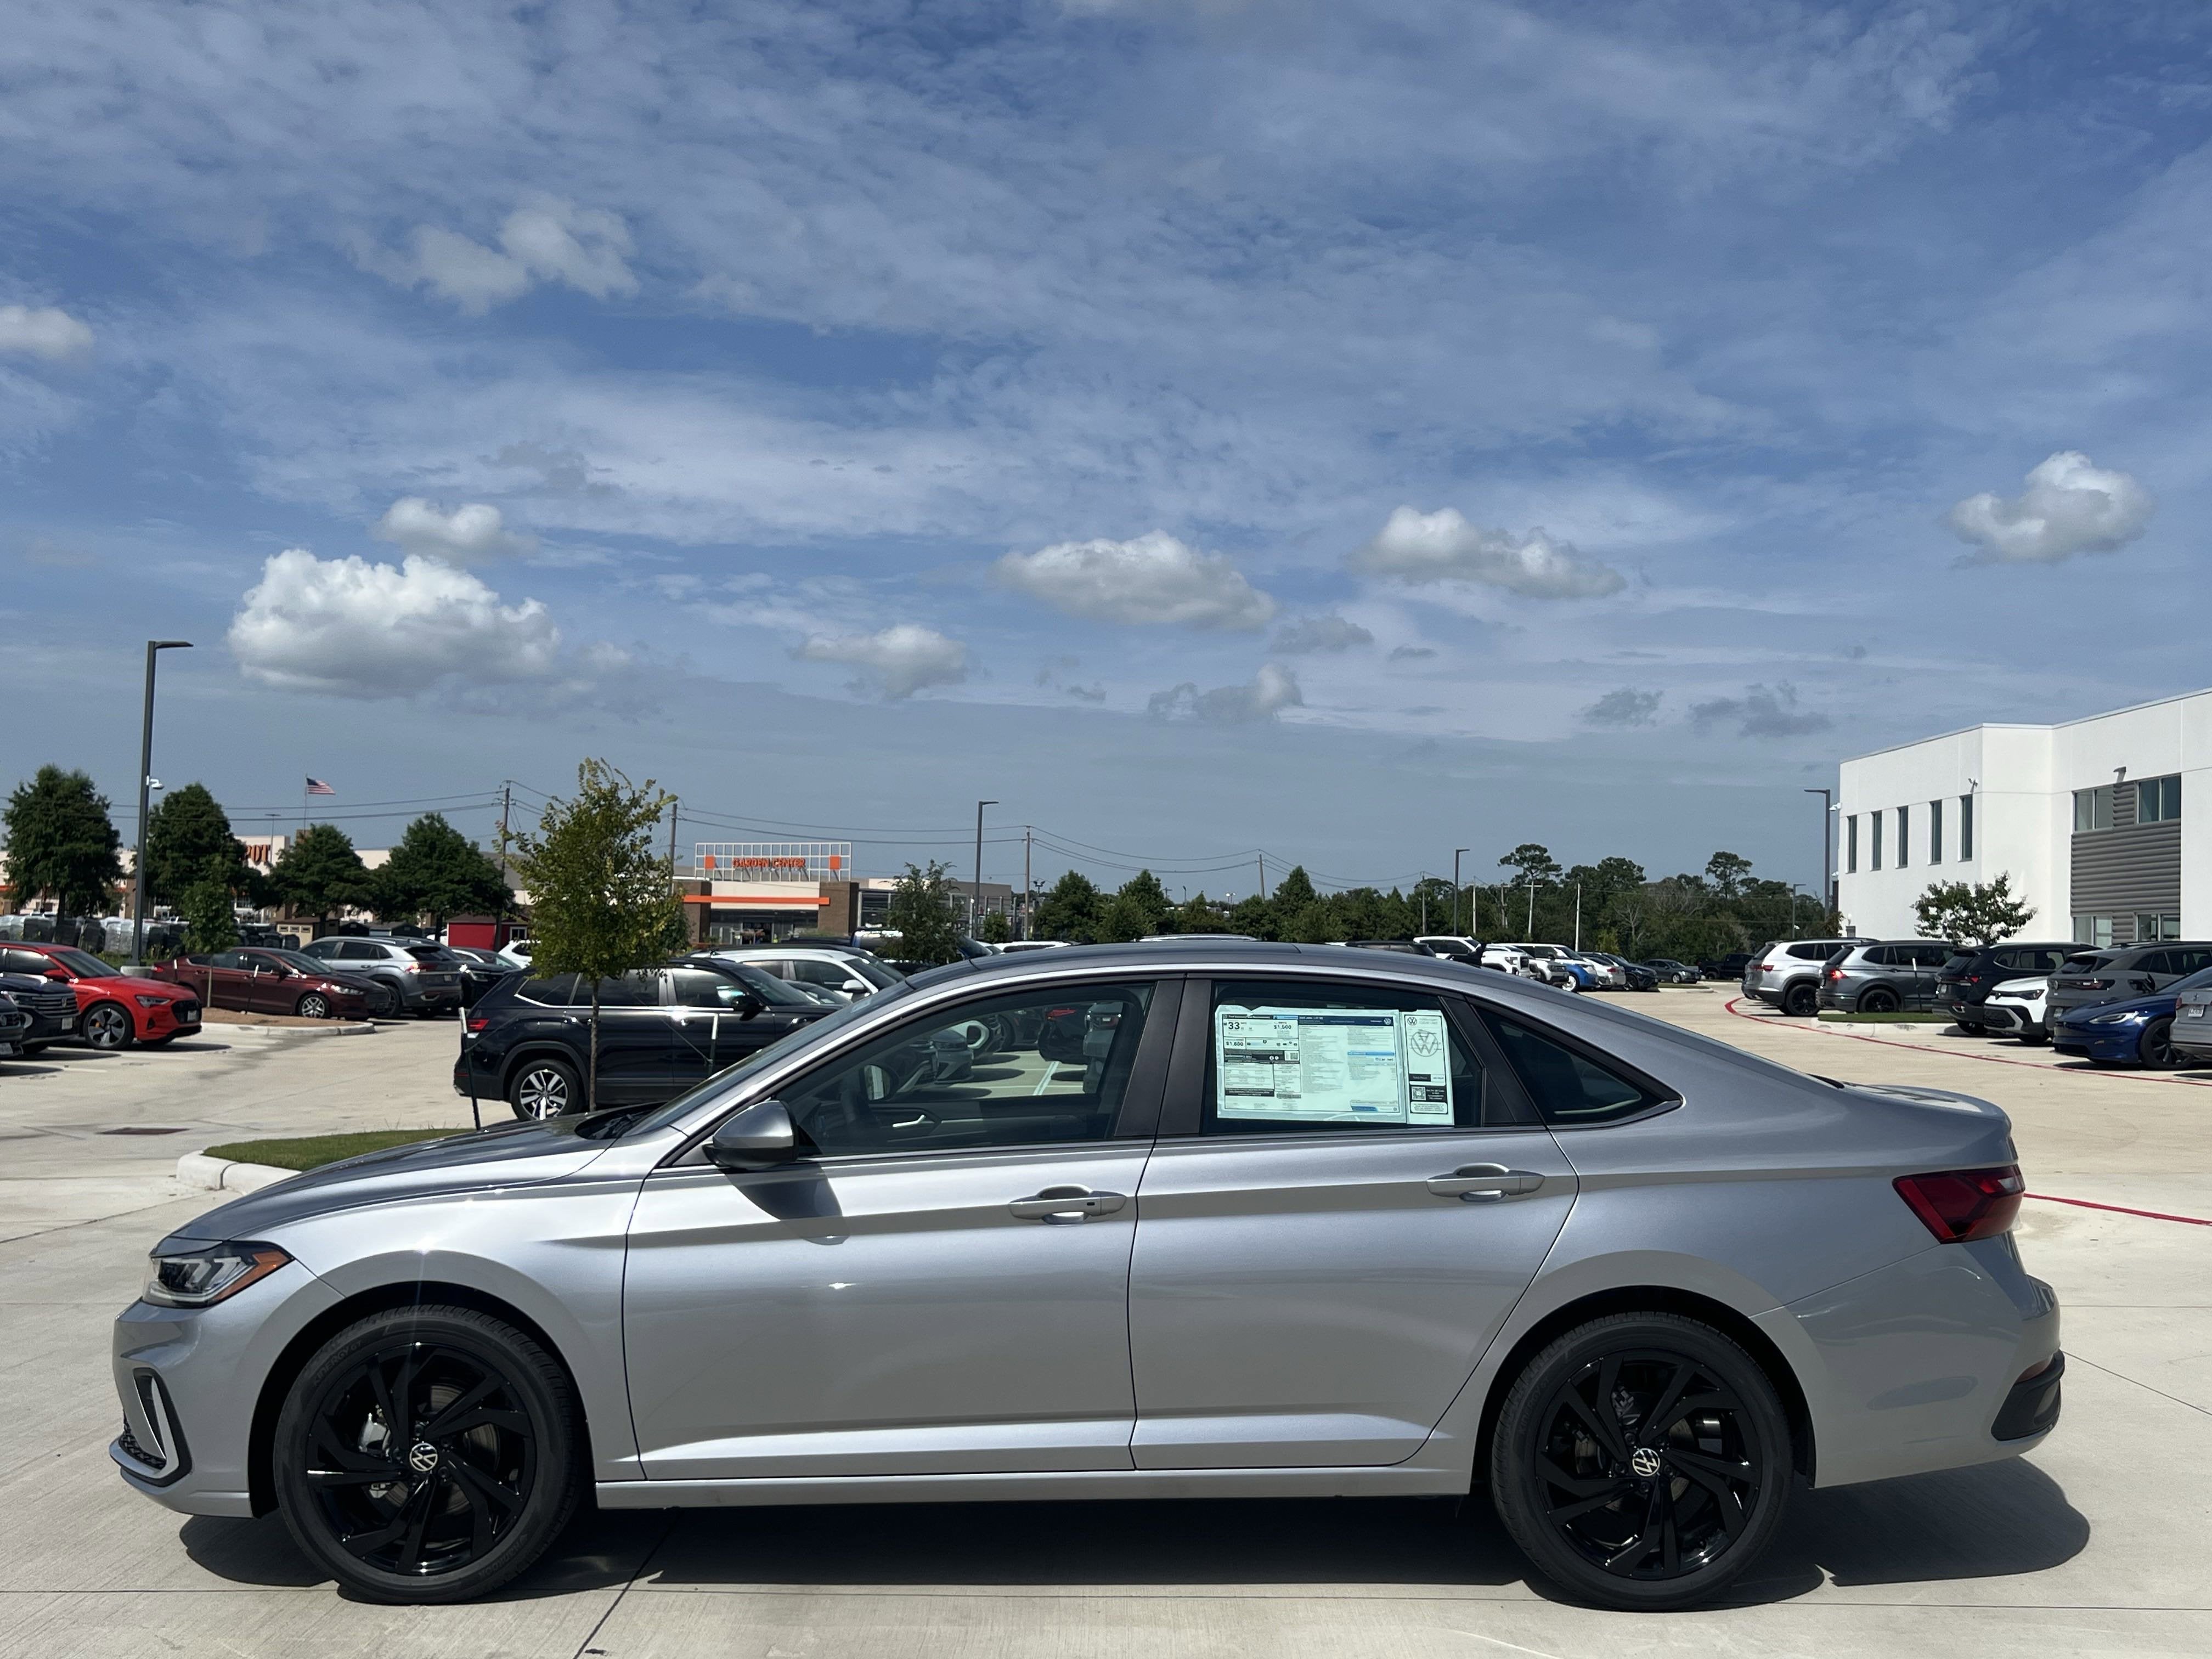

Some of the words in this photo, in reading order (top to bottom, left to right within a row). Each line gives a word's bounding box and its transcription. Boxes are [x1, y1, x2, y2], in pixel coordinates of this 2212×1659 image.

[733, 857, 770, 867] GARDEN
[772, 857, 805, 867] CENTER
[1228, 1022, 1240, 1030] 33
